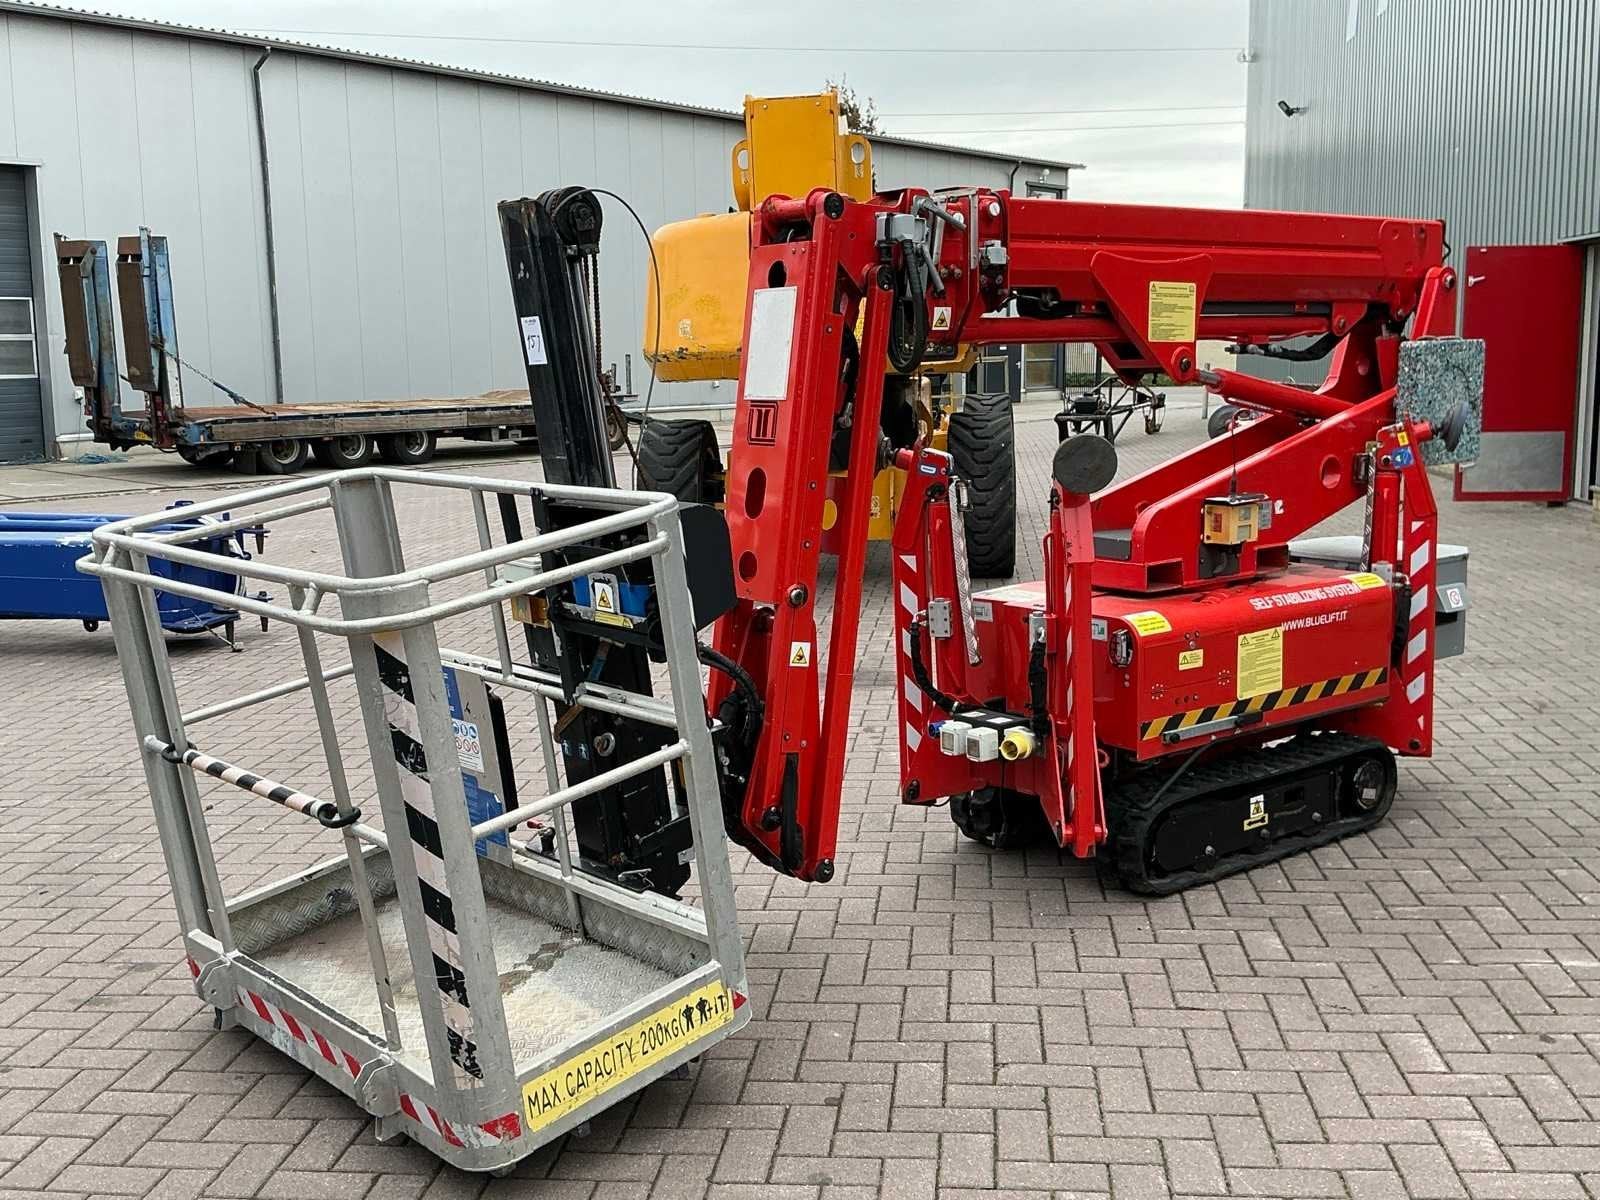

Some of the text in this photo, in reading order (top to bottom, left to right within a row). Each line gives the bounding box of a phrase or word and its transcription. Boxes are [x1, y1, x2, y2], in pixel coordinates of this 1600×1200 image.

[1249, 582, 1361, 610] SELF STABILIZING SYSTEM
[1281, 610, 1348, 632] WWW.BLUELIFT.IT
[565, 1038, 635, 1098] CAPACITY
